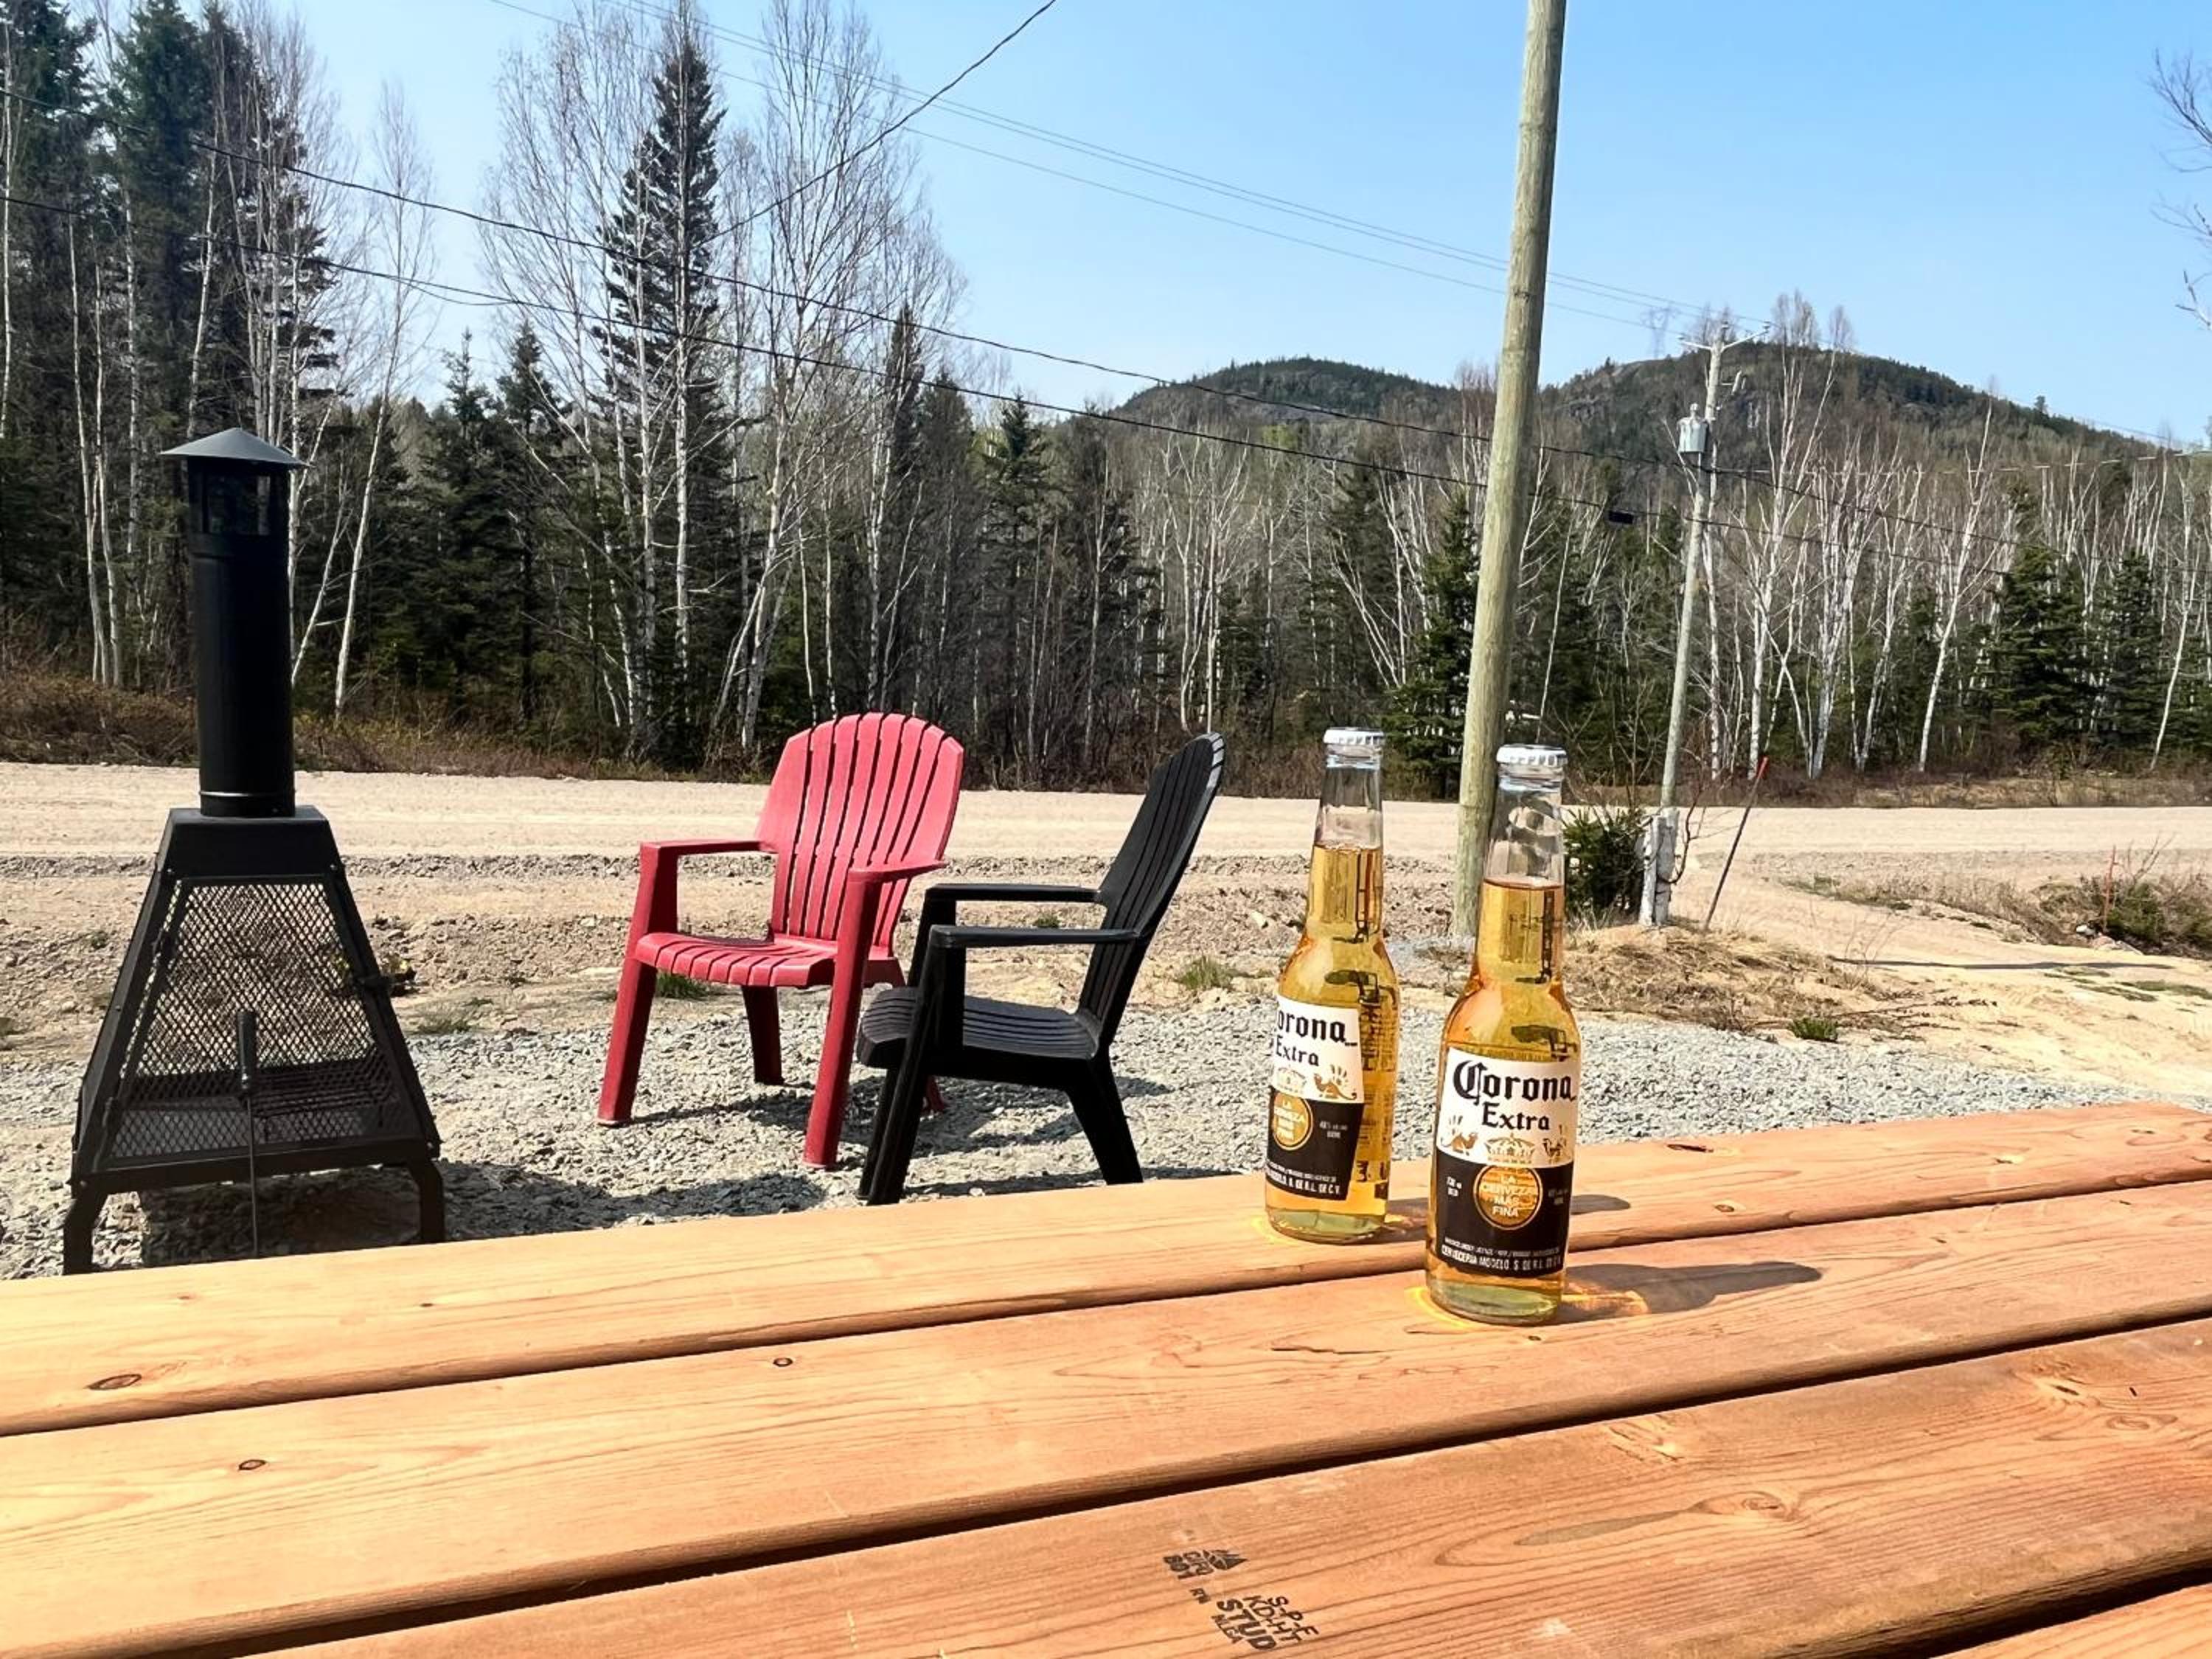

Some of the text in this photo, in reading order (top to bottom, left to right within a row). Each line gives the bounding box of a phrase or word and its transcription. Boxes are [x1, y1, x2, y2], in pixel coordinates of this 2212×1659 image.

[1276, 1010, 1357, 1046] orona
[1276, 1035, 1319, 1067] Extra
[1453, 1060, 1576, 1105] Corona
[1481, 1102, 1550, 1131] Extra
[1492, 1206, 1519, 1217] FINA
[1217, 1598, 1276, 1650] STUD
[1242, 1594, 1303, 1643] KD-HT
[1267, 1596, 1319, 1635] S-P-F
